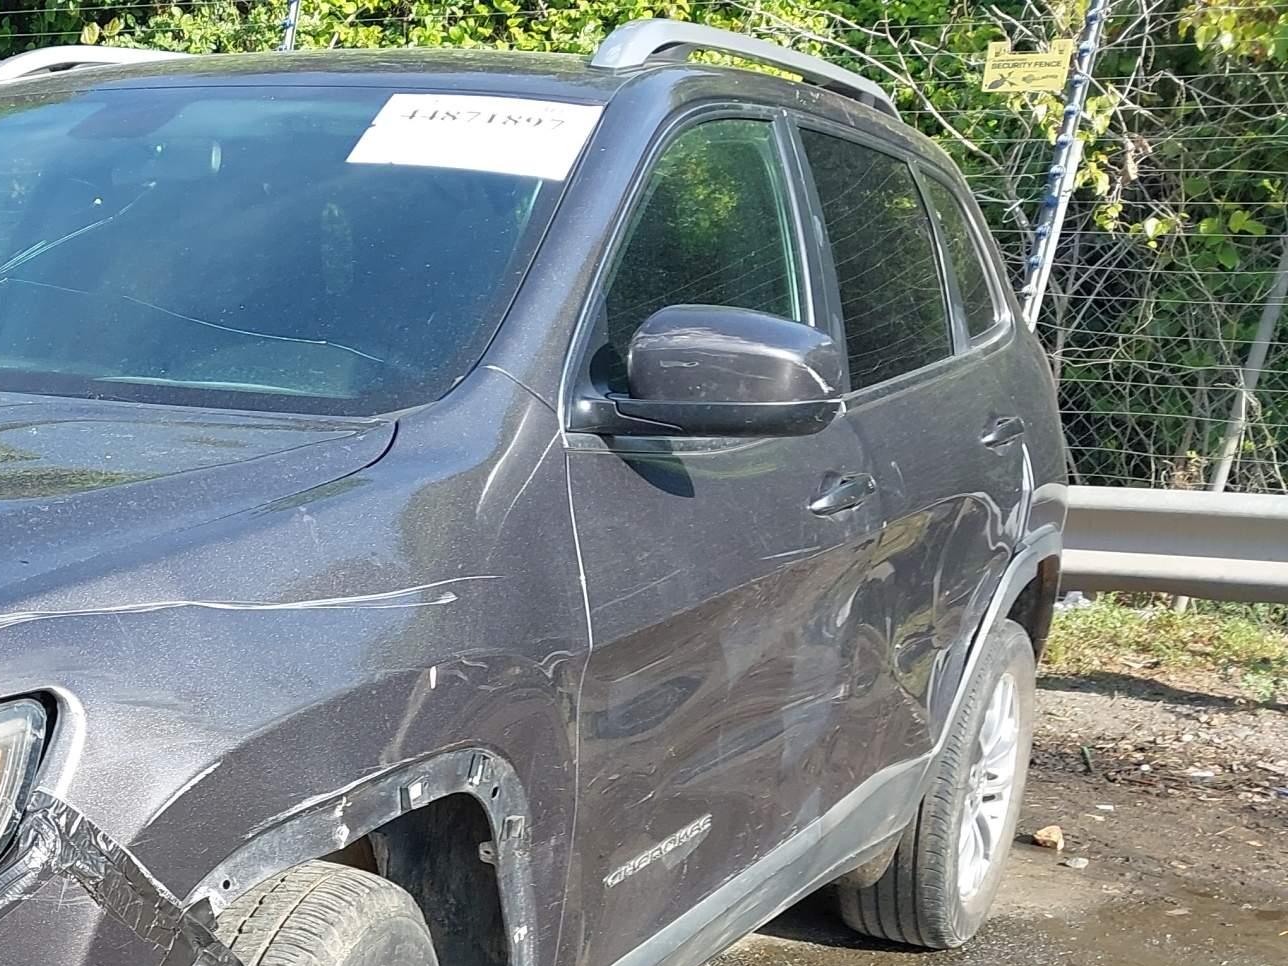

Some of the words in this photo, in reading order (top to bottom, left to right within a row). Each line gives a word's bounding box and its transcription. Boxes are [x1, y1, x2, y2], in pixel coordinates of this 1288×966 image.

[991, 61, 1032, 70] SECURITY
[1034, 60, 1062, 68] FENCE
[399, 108, 566, 130] 44871897
